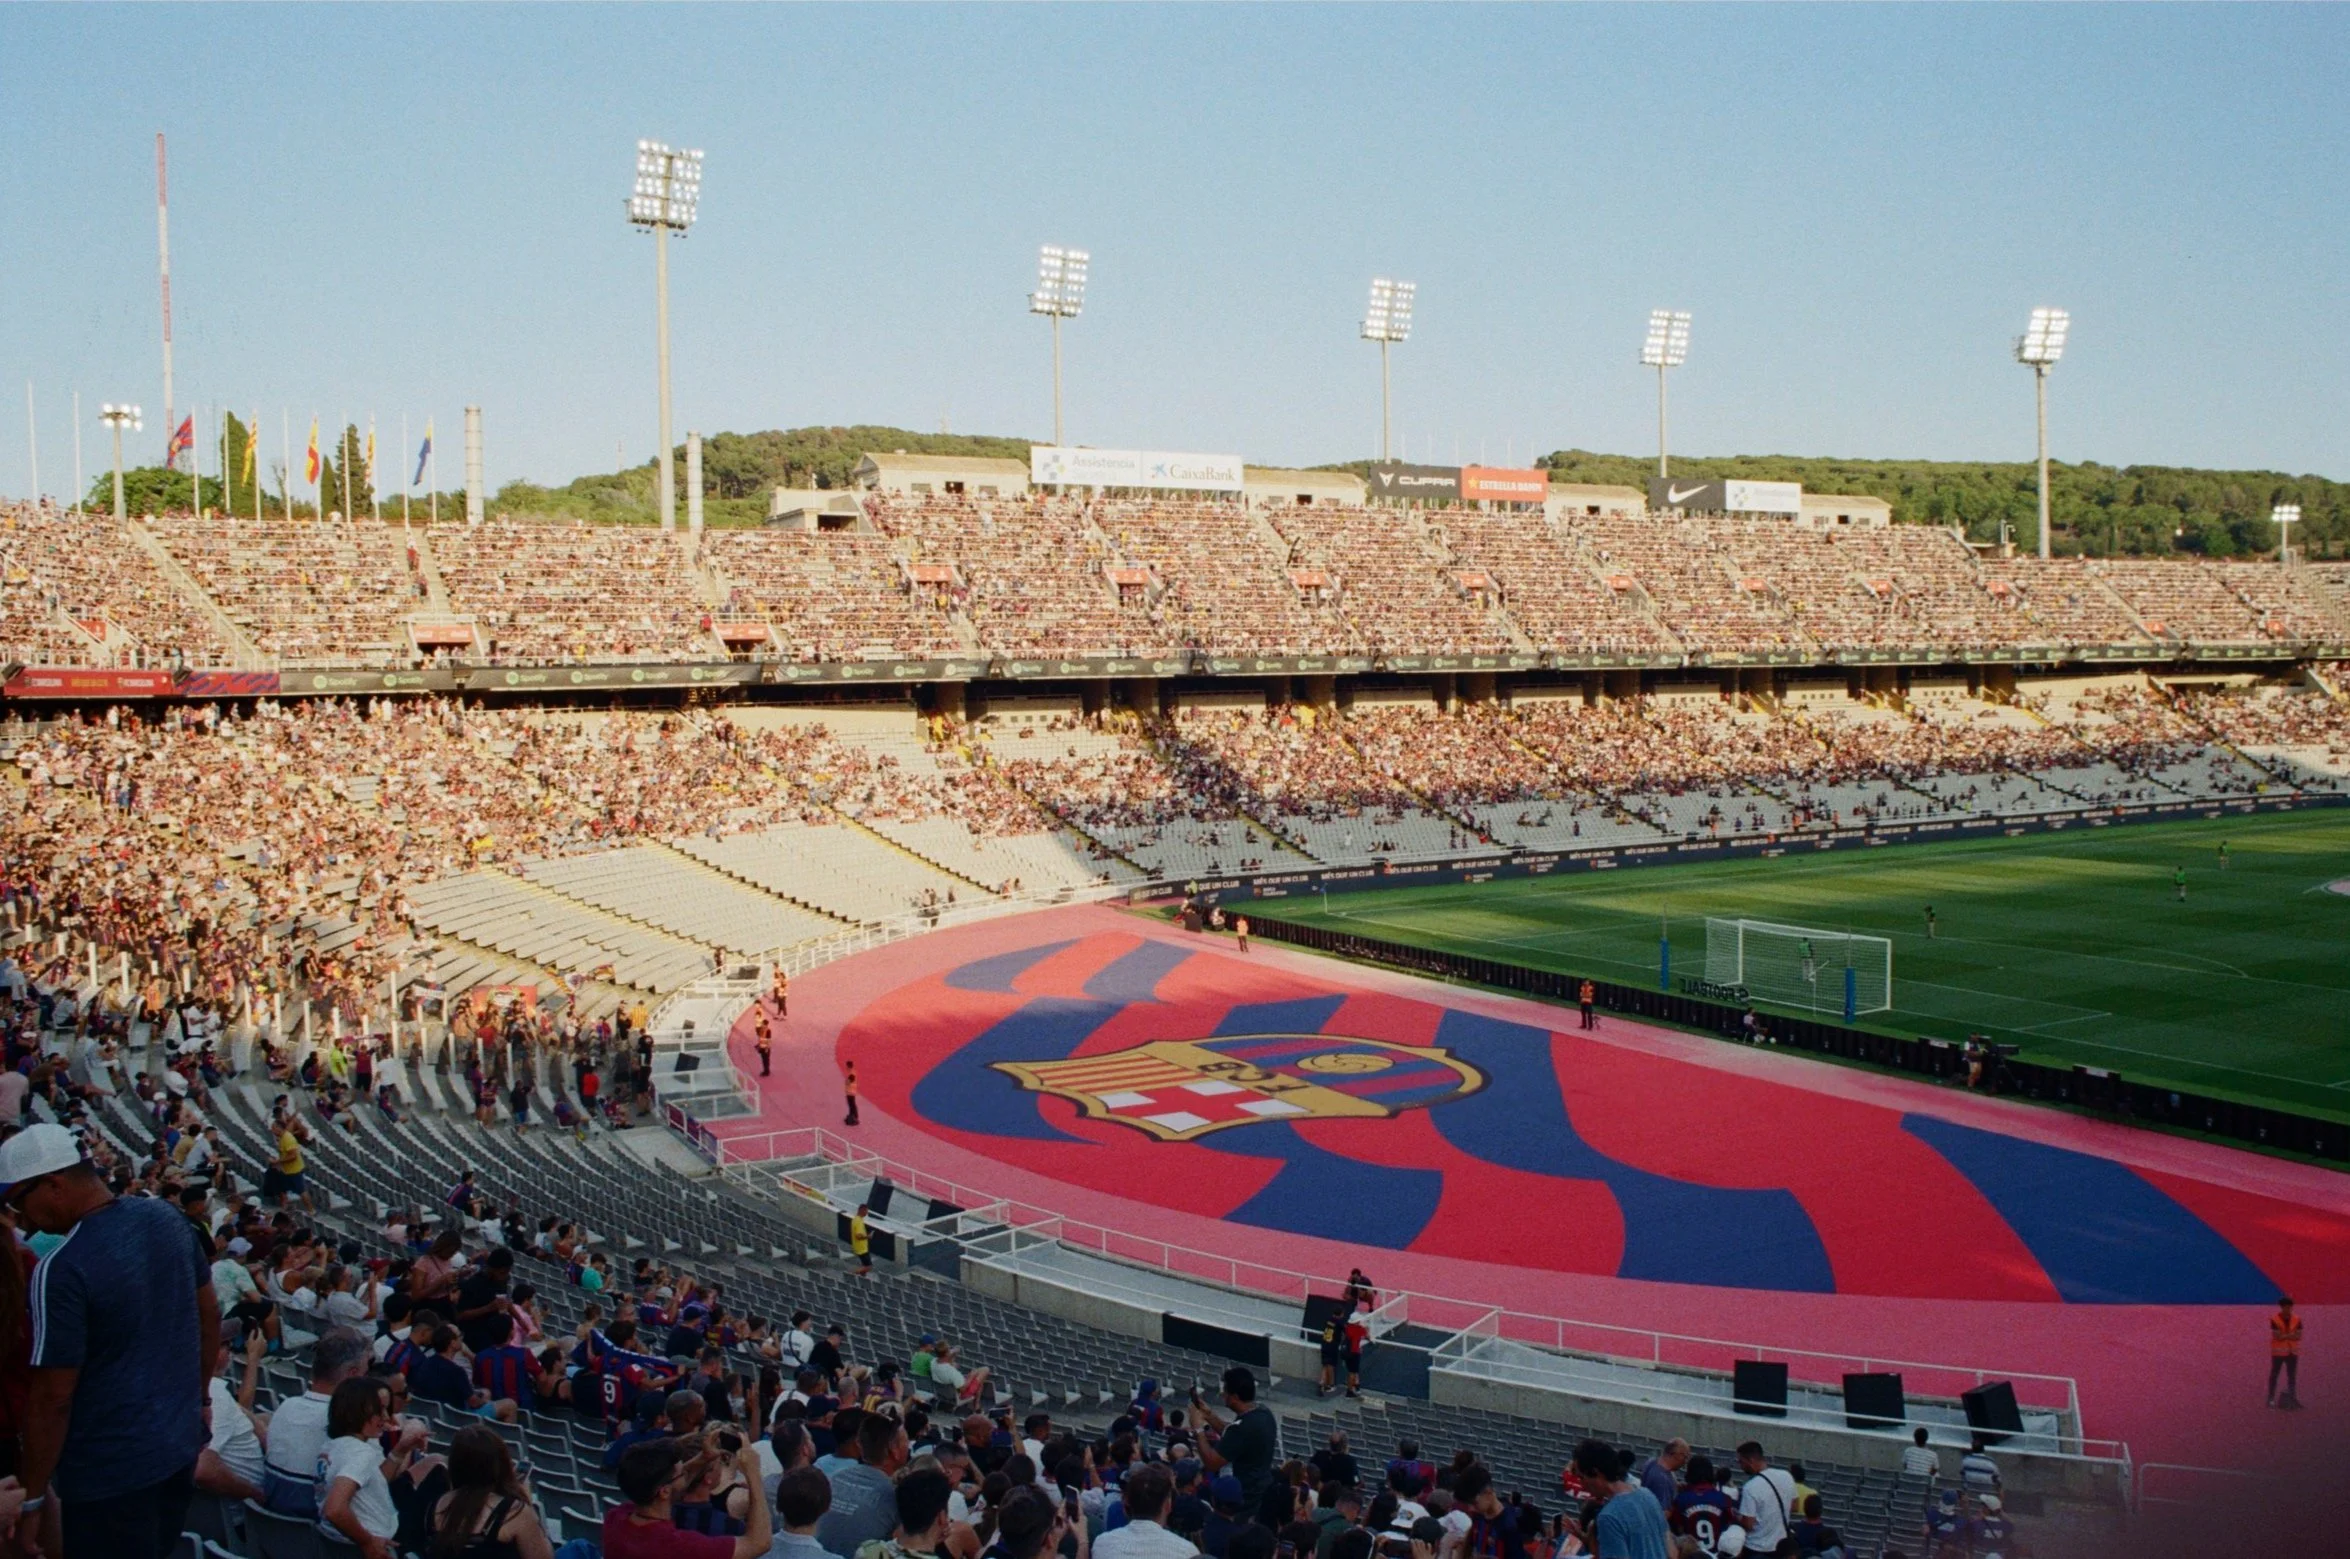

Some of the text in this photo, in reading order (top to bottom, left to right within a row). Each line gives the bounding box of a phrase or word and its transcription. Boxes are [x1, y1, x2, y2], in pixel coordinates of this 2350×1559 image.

[1170, 464, 1235, 481] CaixaBank
[1399, 476, 1456, 487] CUPRA
[329, 678, 357, 687] Spotify
[398, 676, 424, 685] Spotify
[520, 675, 546, 683] Spotify
[1222, 880, 1240, 889] CLUB
[603, 1380, 616, 1404] 9
[1696, 1520, 1714, 1550] 9
